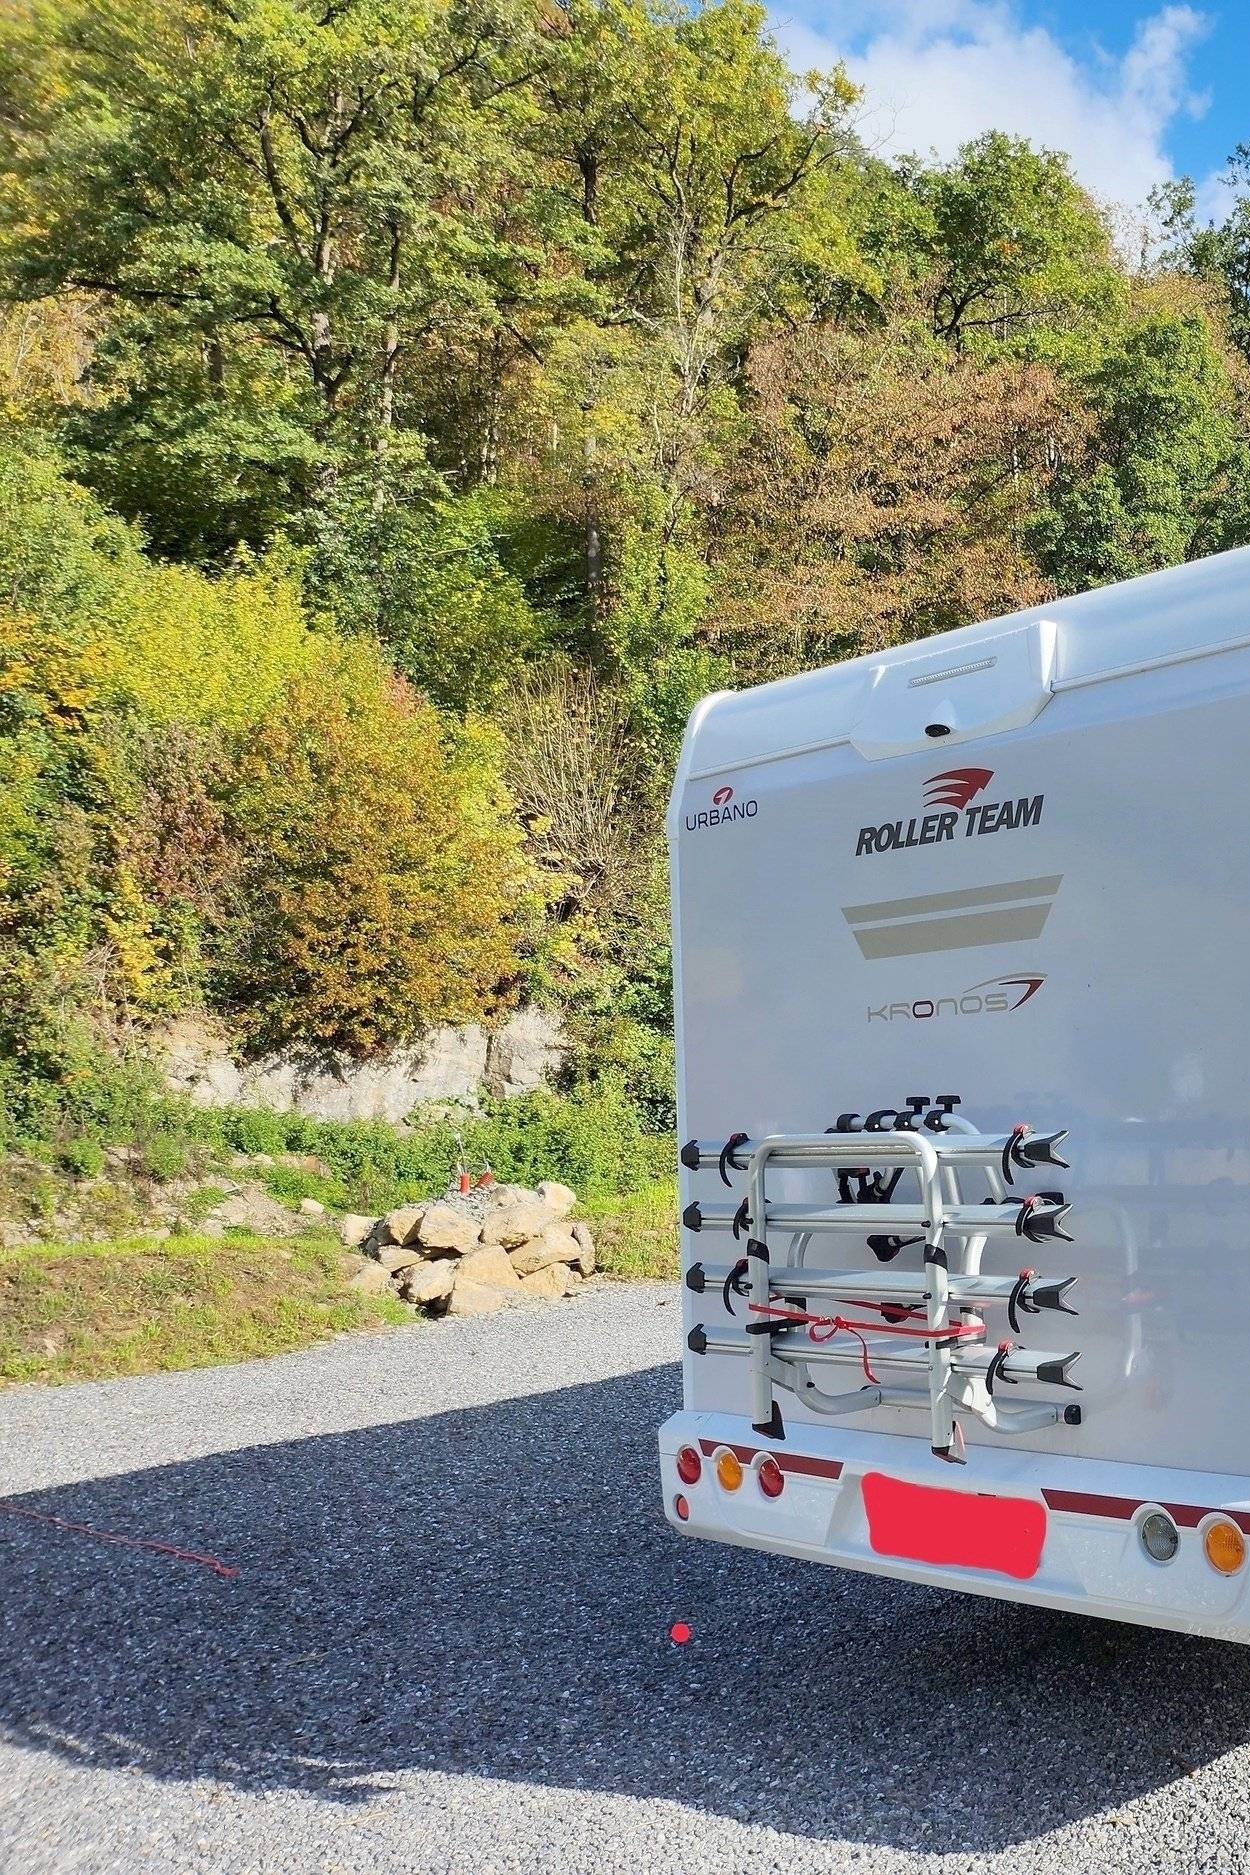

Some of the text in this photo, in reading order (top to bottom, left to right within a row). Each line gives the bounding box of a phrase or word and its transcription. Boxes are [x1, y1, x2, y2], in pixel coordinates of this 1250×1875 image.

[685, 800, 758, 831] URBANO
[855, 794, 1045, 856] ROLLER TEAM
[866, 992, 1010, 1023] KRONOS
